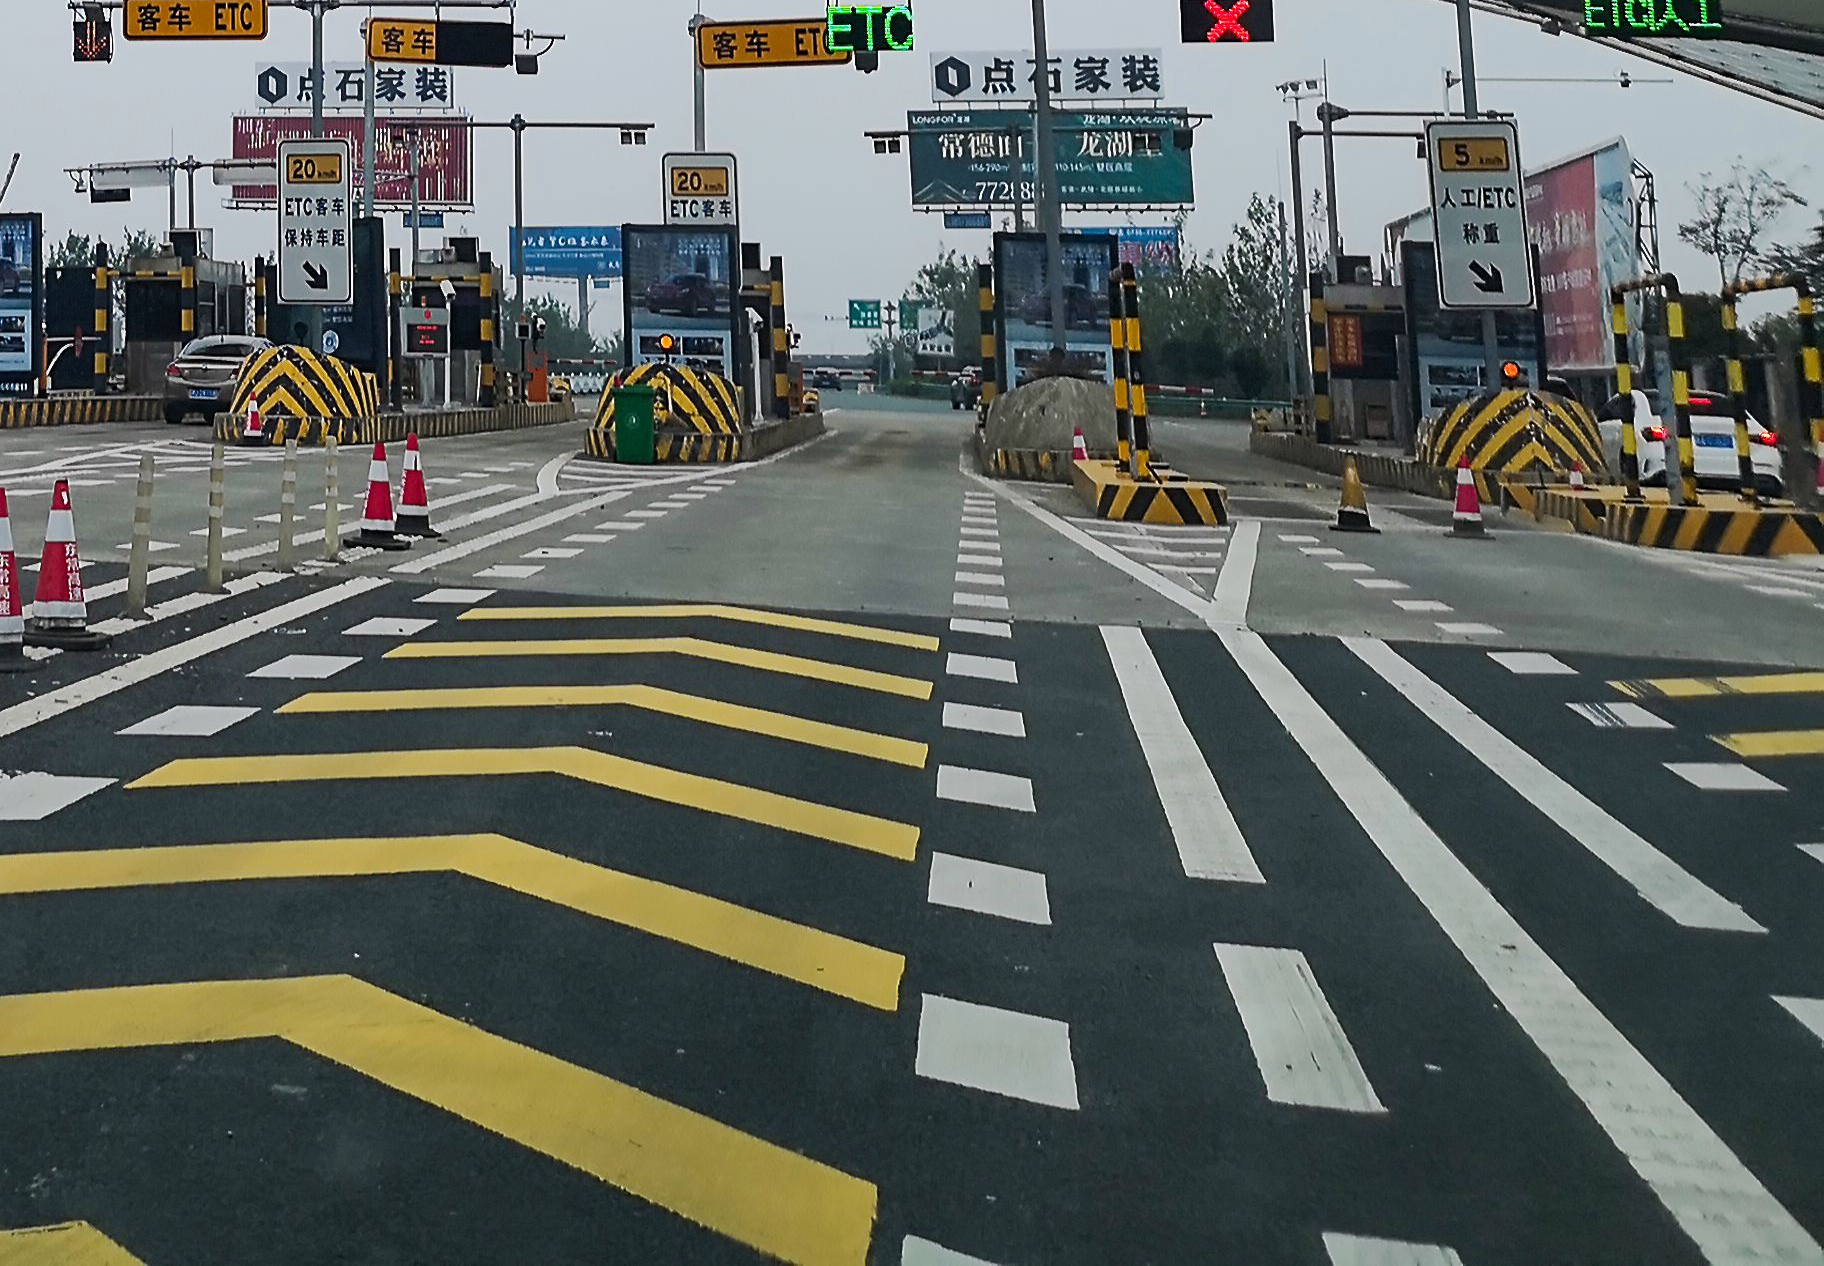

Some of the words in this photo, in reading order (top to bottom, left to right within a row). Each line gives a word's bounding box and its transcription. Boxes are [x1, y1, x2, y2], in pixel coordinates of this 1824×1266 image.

[136, 3, 192, 32] 客车
[214, 1, 254, 32] ETC
[827, 5, 914, 51] ETC
[381, 26, 435, 55] 客车
[712, 30, 771, 60] 客车
[296, 67, 449, 103] 点石家装
[981, 55, 1161, 95] 点石家装
[292, 158, 316, 179] 20
[1454, 143, 1470, 166] 5
[677, 171, 702, 192] 20
[284, 227, 346, 247] 保持车距
[1462, 221, 1500, 245] 称重
[63, 542, 83, 602] 东常高速
